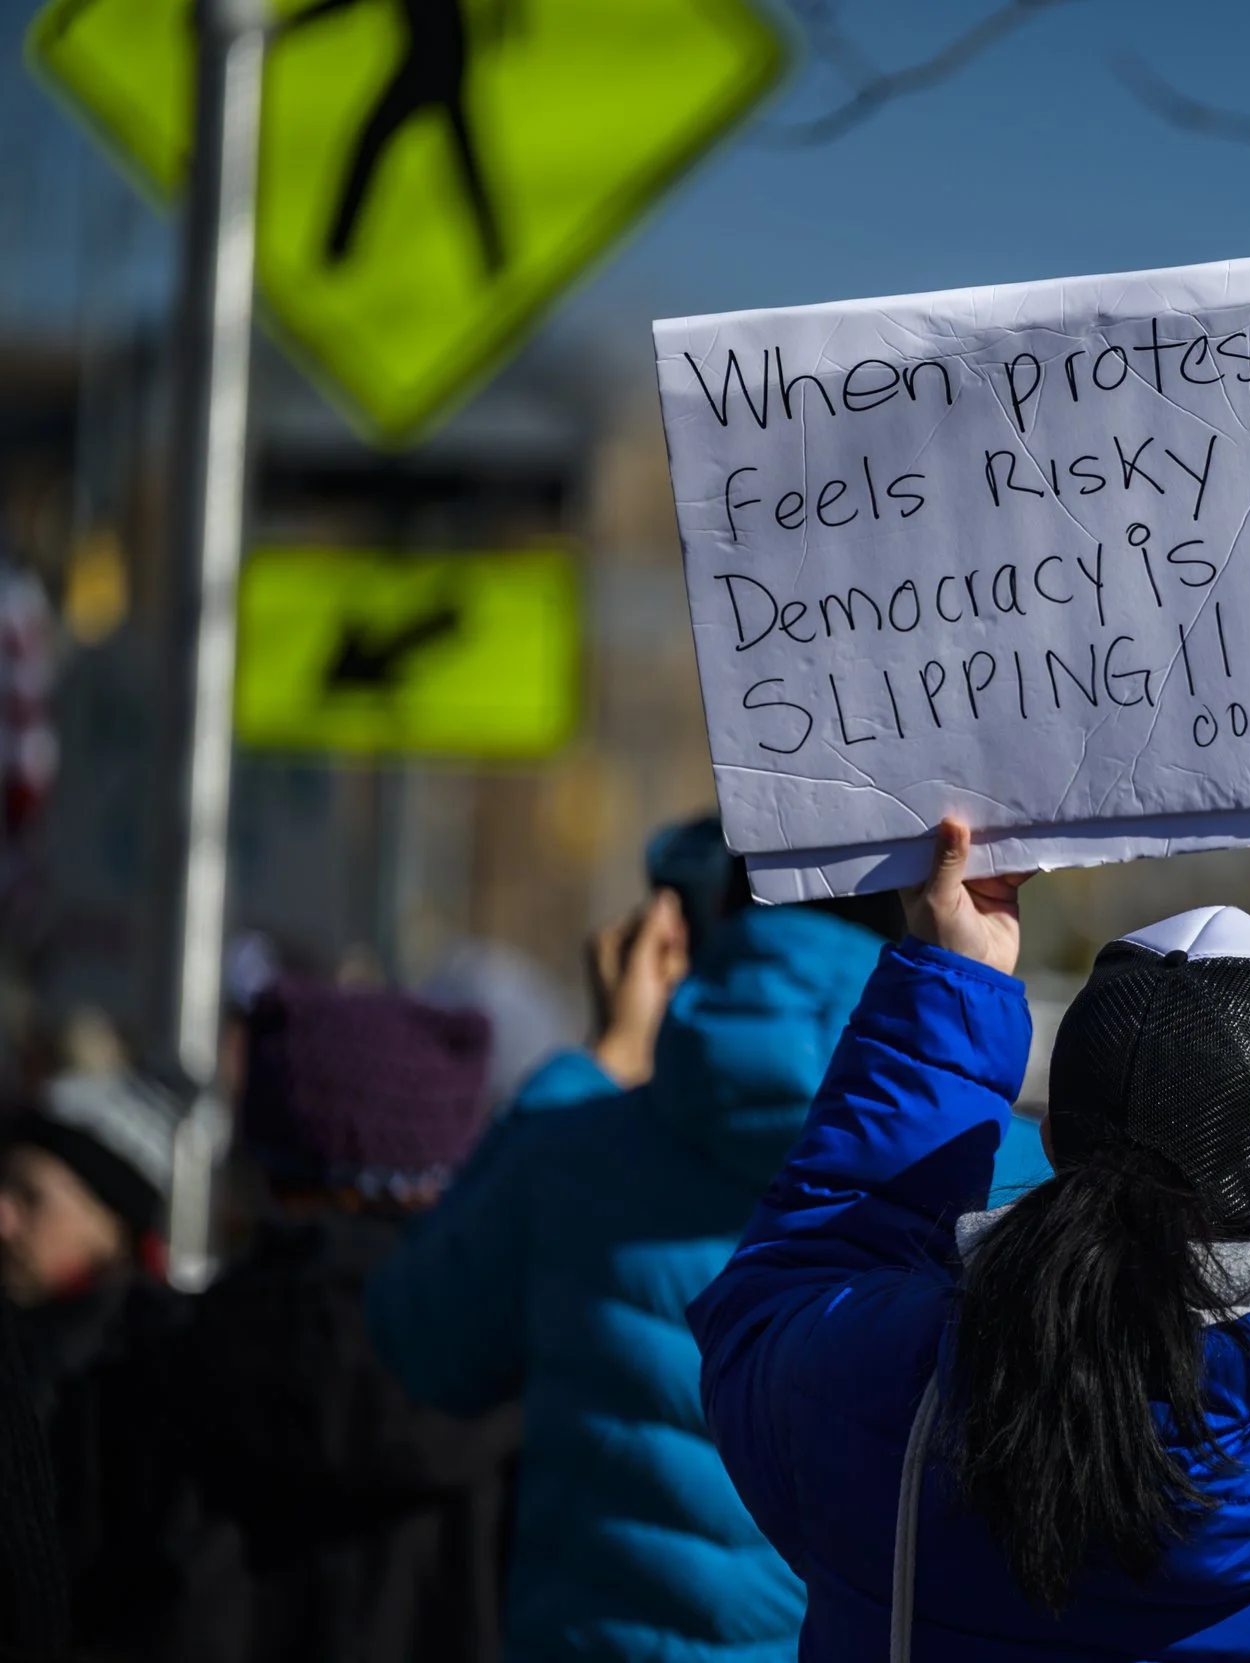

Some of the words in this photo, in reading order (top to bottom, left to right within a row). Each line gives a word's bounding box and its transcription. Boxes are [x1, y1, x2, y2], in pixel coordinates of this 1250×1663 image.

[685, 346, 954, 430] When
[714, 542, 1105, 653] Democracy
[1126, 522, 1218, 607] is
